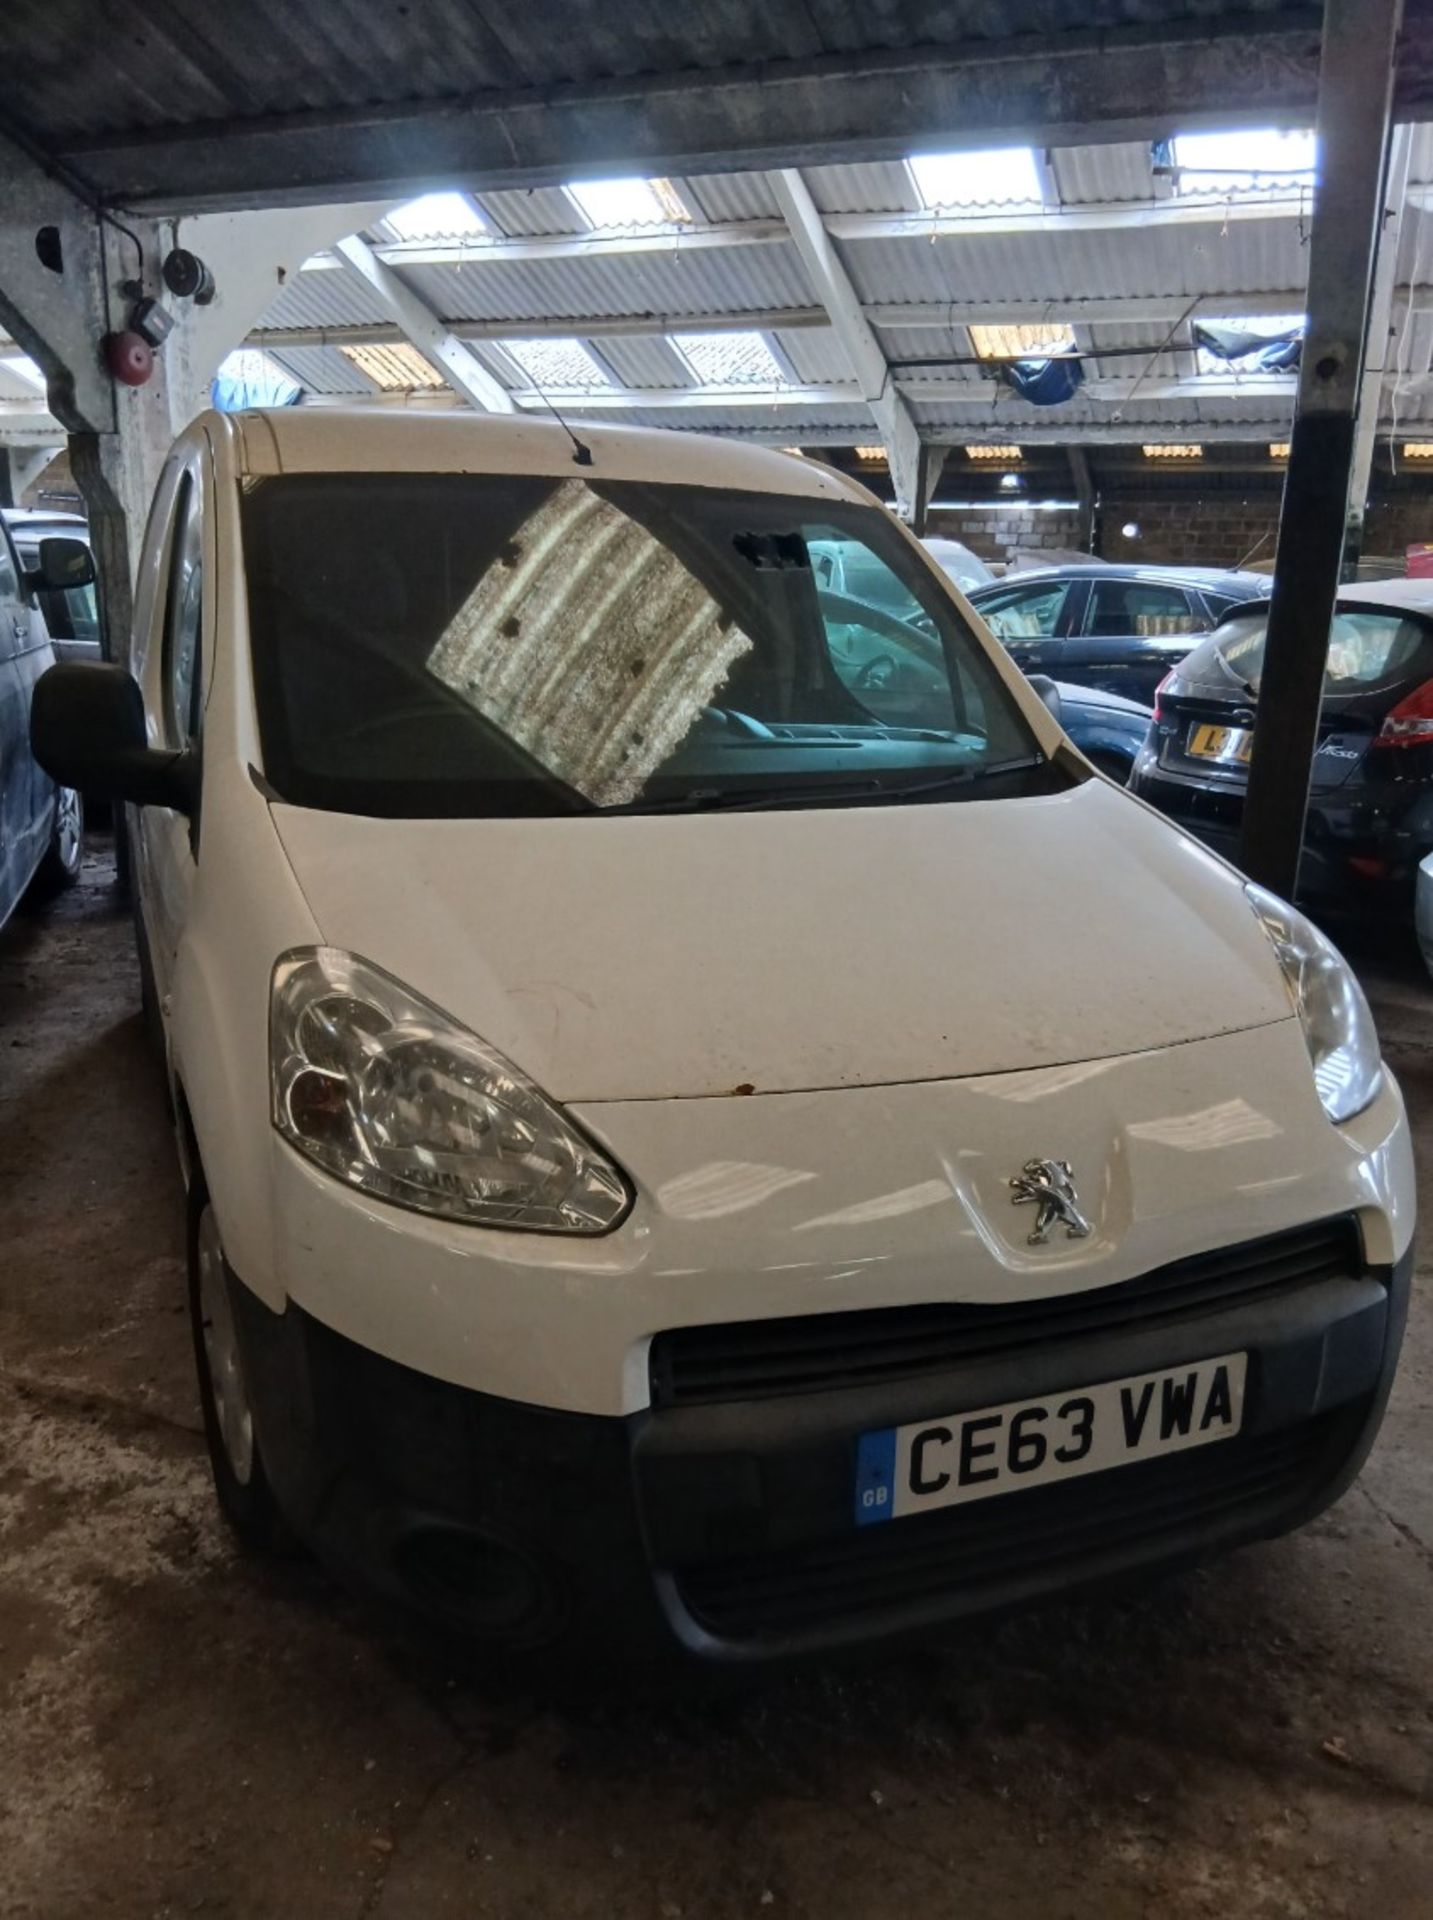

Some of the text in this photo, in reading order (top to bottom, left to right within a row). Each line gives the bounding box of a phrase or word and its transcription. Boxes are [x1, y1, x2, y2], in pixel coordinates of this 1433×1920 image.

[908, 1365, 1232, 1495] CE63 VWA
[863, 1486, 888, 1508] GB
